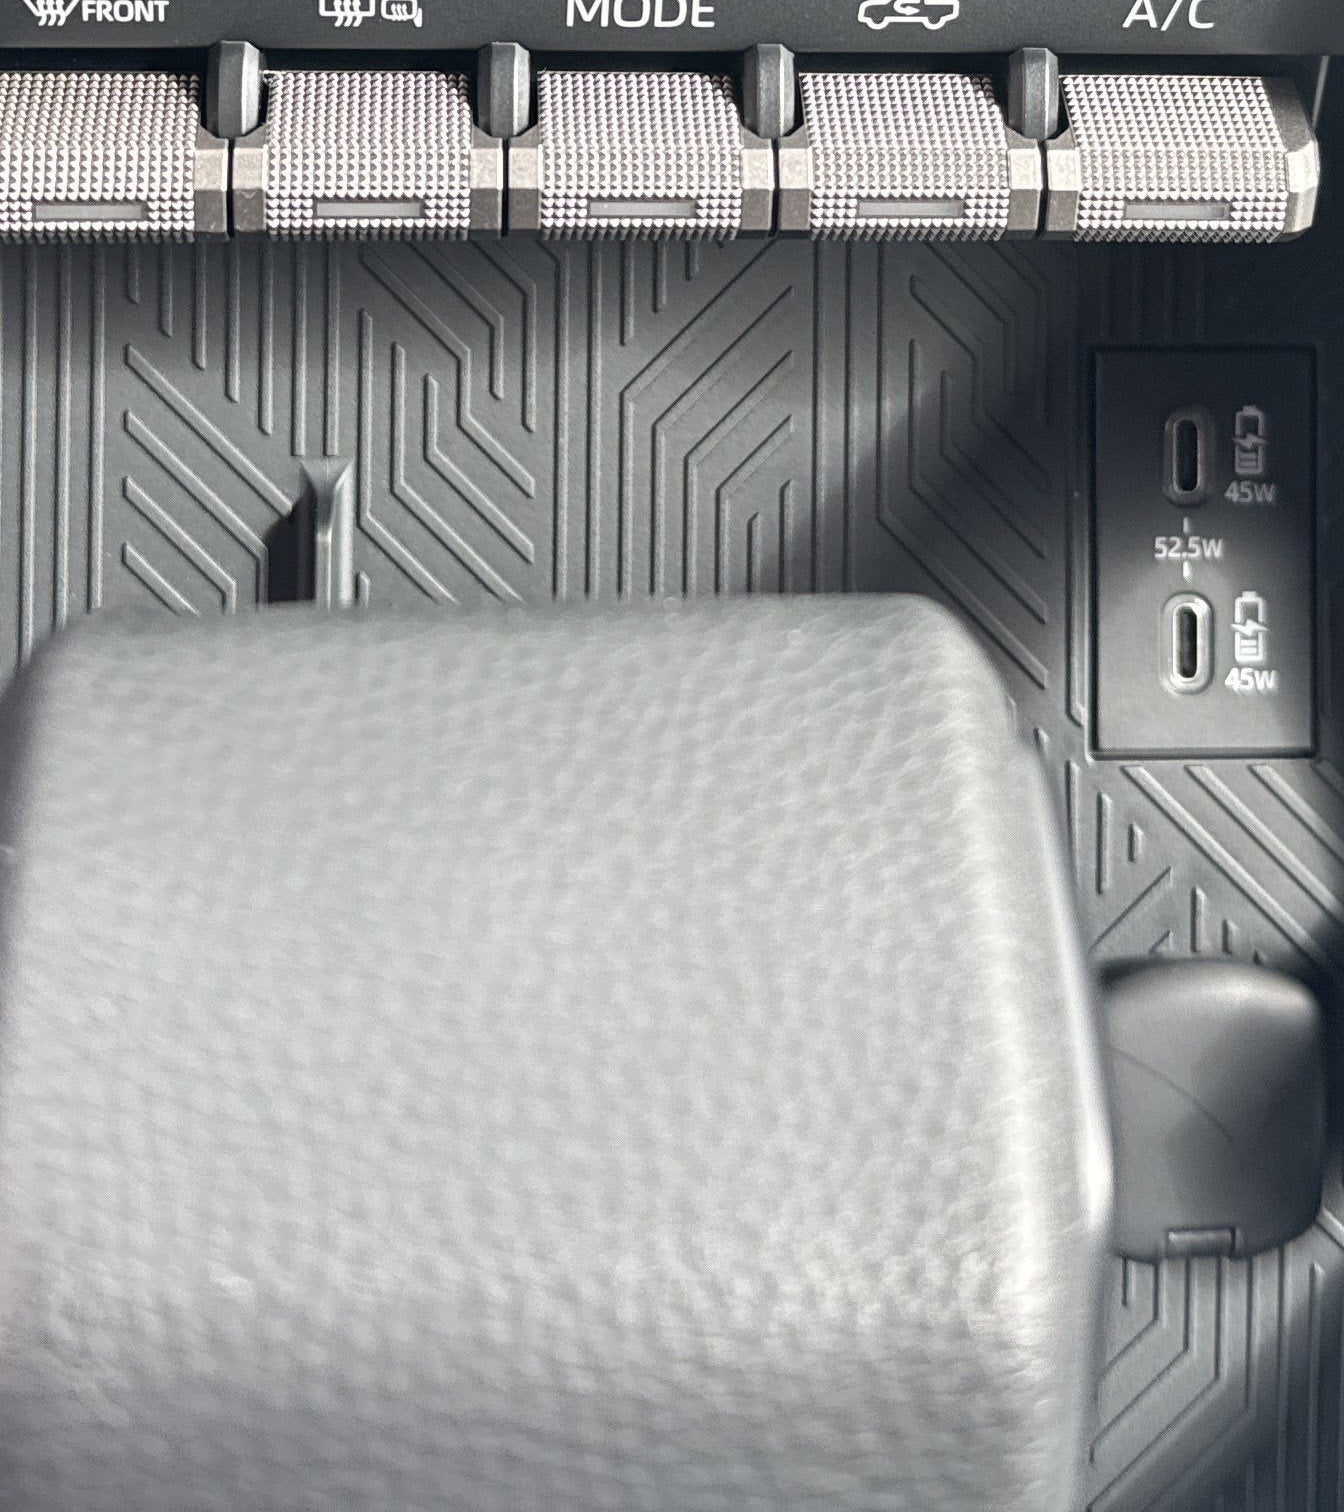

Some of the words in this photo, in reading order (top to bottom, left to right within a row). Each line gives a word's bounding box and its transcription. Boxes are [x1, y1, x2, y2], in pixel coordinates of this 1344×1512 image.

[81, 0, 170, 25] FRONT
[1224, 482, 1276, 504] 45W
[1154, 536, 1224, 560] 52.5W
[1224, 667, 1277, 692] 45W
